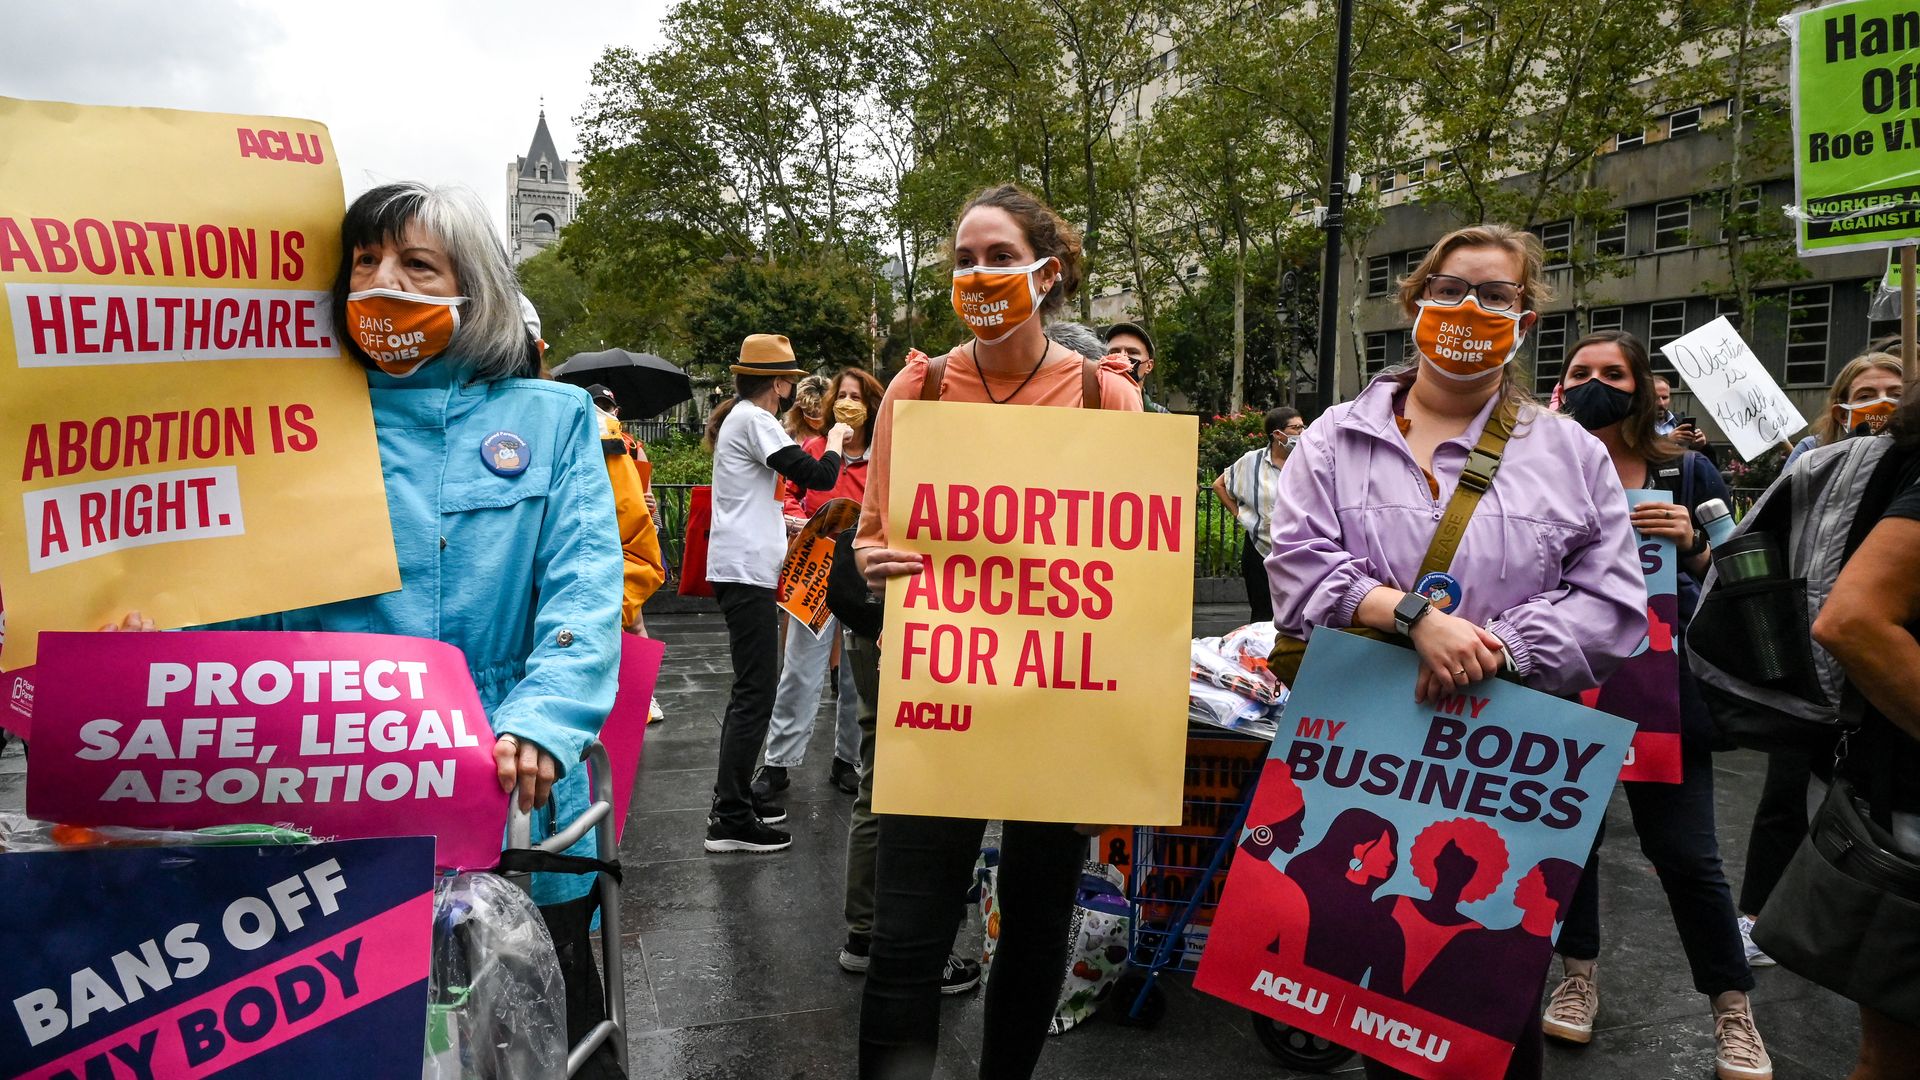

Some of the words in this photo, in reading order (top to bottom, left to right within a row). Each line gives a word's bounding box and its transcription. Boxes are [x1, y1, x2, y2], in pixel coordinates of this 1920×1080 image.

[237, 128, 324, 164] ACLU
[1809, 128, 1873, 163] Roe
[1882, 117, 1920, 152] V.
[1809, 192, 1904, 216] WORKERS
[1829, 210, 1909, 232] AGAINST
[0, 217, 257, 279] ABORTION
[270, 230, 305, 281] IS
[961, 291, 984, 303] BANS
[962, 303, 978, 314] OFF
[980, 300, 1009, 314] OUR
[26, 295, 332, 354] HEALTHCARE.
[360, 315, 393, 332] BANS
[360, 332, 384, 348] OFF
[387, 331, 426, 348] OUR
[1437, 333, 1461, 347] OFF
[1463, 340, 1492, 351] OUR
[1440, 322, 1472, 337] BANS
[1435, 345, 1483, 362] BODIES
[1723, 369, 1747, 388] is
[22, 407, 255, 481] ABORTION
[269, 403, 318, 453] IS
[40, 500, 69, 558] A
[80, 477, 231, 547] RIGHT.
[906, 483, 1182, 552] ABORTION
[801, 552, 833, 606] WITHOUT
[802, 562, 817, 588] AND
[903, 553, 1113, 620] ACCESS
[901, 622, 997, 685] FOR
[1013, 630, 1117, 692] ALL.
[147, 660, 428, 706] PROTECT
[894, 701, 972, 732] ACLU
[1436, 695, 1490, 719] MY
[75, 717, 278, 764] SAFE,
[299, 710, 478, 756] LEGAL
[1295, 717, 1346, 741] MY
[1421, 716, 1605, 783] BODY
[99, 759, 456, 804] ABORTION
[1286, 740, 1589, 829] BUSINESS
[13, 922, 210, 1047] BANS
[222, 857, 348, 951] OFF
[177, 936, 364, 1068] BODY
[1250, 969, 1329, 1015] ACLU
[1351, 1007, 1450, 1062] NYCLU
